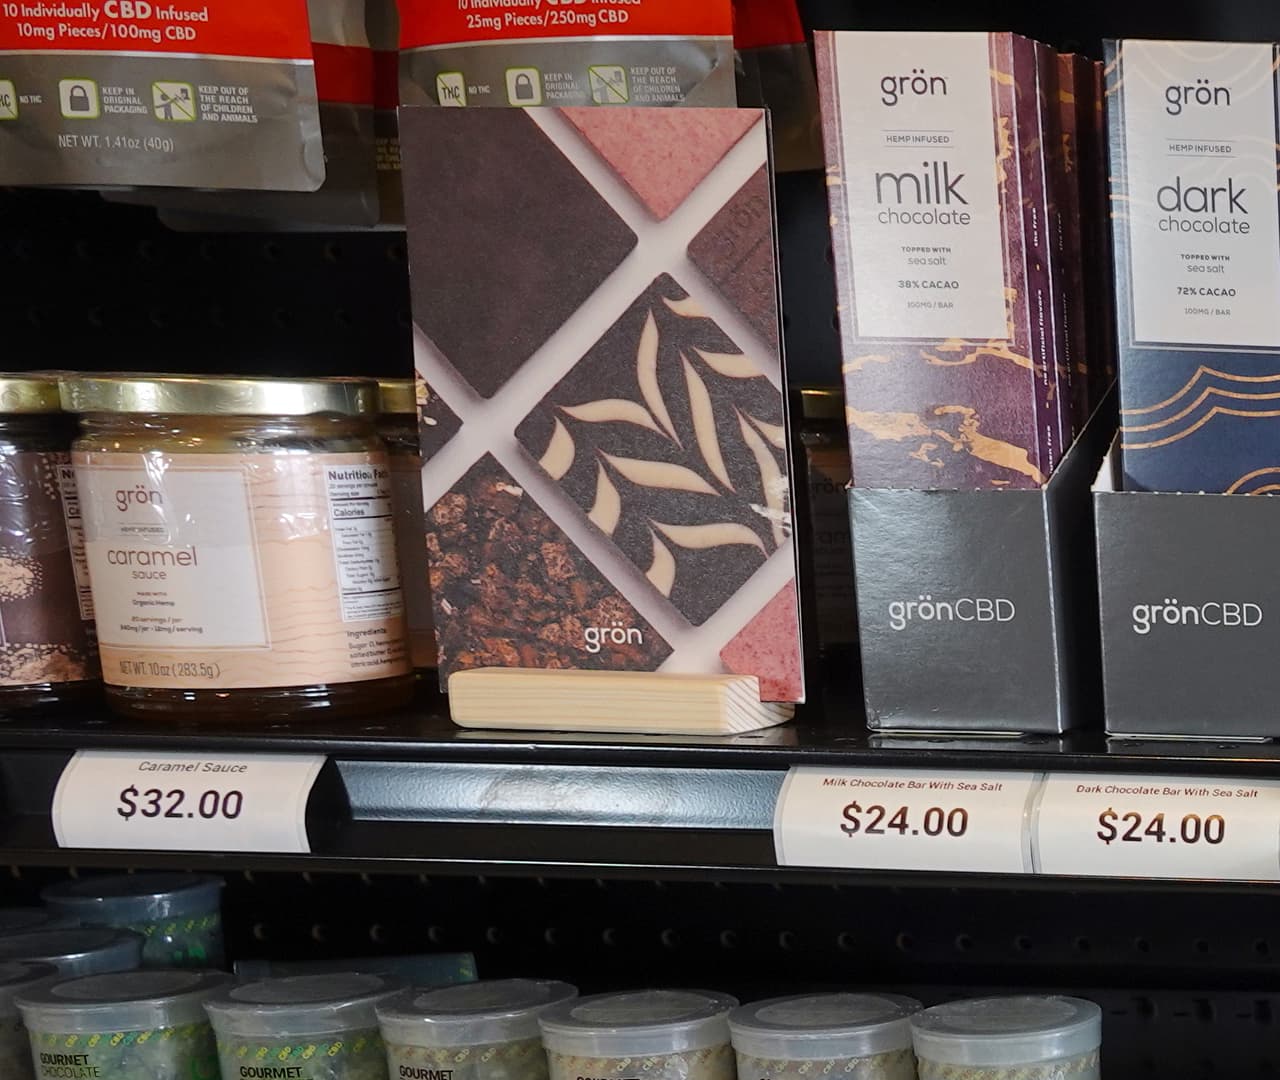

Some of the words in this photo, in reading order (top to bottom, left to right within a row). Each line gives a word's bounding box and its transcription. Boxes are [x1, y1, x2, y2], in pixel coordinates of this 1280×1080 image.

[3, 3, 18, 18] 10
[21, 3, 100, 23] Individually
[103, 0, 152, 20] CBD
[156, 6, 209, 23] Infused
[466, 13, 502, 31] 25mg
[504, 10, 597, 28] Pieces/250mg
[599, 9, 629, 23] CBD
[16, 23, 55, 41] 10mg
[58, 23, 162, 43] Pieces/100mg
[165, 25, 196, 41] CBD
[880, 68, 948, 107] grön
[58, 134, 78, 148] NET
[105, 136, 140, 149] 1.41oz
[143, 137, 174, 153] (40g)
[886, 135, 911, 143] HEMP
[912, 135, 950, 144] INFUSED
[875, 160, 969, 205] milk
[1156, 176, 1248, 215] dark
[878, 208, 971, 226] chocolate
[1158, 215, 1250, 234] chocolate
[908, 256, 927, 265] sea
[928, 256, 947, 266] salt
[898, 280, 920, 289] 38%
[921, 280, 959, 289] CACAO
[1177, 287, 1197, 295] 72%
[1199, 287, 1237, 297] CACAO
[107, 546, 198, 567] caramel
[132, 569, 167, 580] sauce
[888, 594, 1016, 630] grönCBD
[583, 623, 643, 655] grön
[138, 761, 200, 773] Caramel
[201, 762, 248, 773] Sauce
[823, 777, 848, 788] Milk
[850, 778, 905, 790] Chocolate
[907, 780, 927, 790] Bar
[928, 780, 955, 791] With
[957, 782, 978, 792] Sea
[980, 782, 1004, 792] Salt
[1075, 784, 1103, 795] Dark
[1103, 785, 1160, 796] Chocolate
[1162, 787, 1182, 796] Bar
[1183, 787, 1210, 797] With
[1212, 788, 1233, 798] Sea
[1235, 788, 1259, 799] Salt
[117, 784, 244, 821] $32.00
[839, 800, 969, 837] $24.00
[1096, 807, 1225, 845] $24.00
